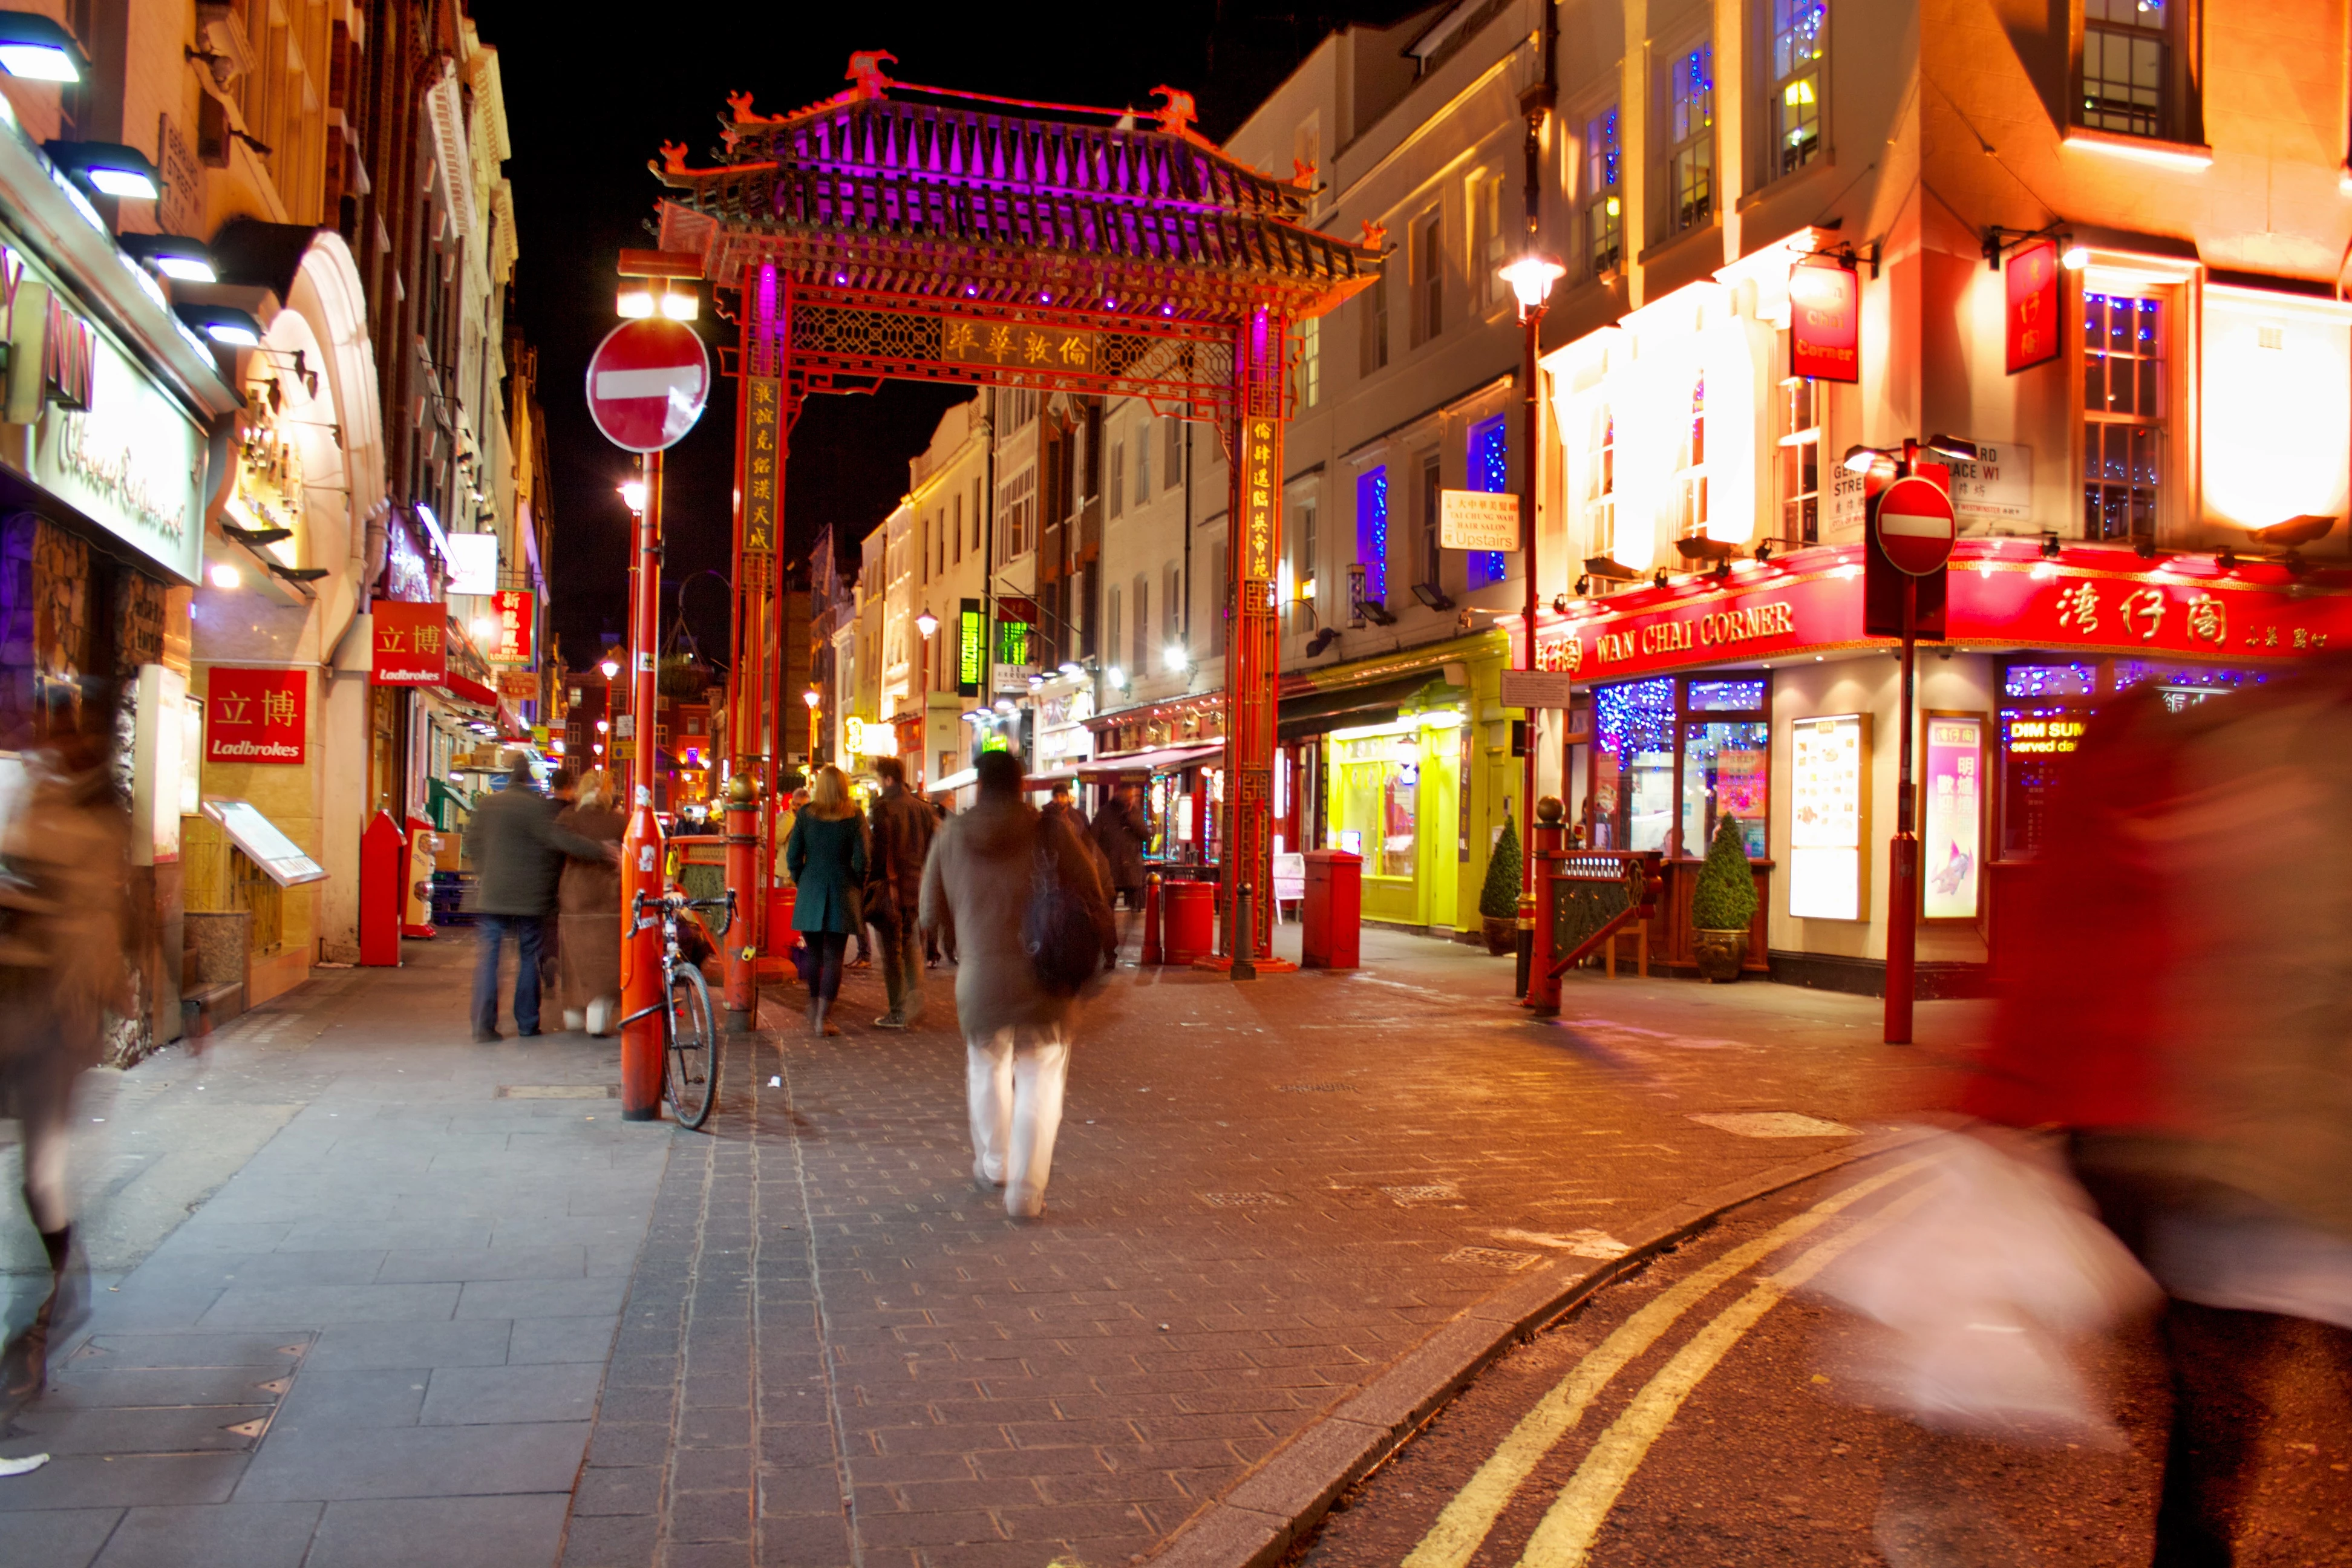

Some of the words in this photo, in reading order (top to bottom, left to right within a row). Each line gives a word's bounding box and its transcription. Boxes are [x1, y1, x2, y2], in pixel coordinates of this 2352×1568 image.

[1806, 309, 1845, 328] Chai
[1796, 339, 1854, 361] Corner
[1982, 466, 1999, 481] W1
[1834, 477, 1866, 497] STRE
[1465, 512, 1494, 520] CHUNG
[1496, 514, 1514, 522] WAH
[1961, 503, 2001, 514] WESTMINSTER
[1457, 532, 1512, 547] Upstairs
[376, 625, 441, 655] 立博
[1596, 630, 1636, 665] WAN
[1642, 619, 1694, 655] CHAI
[1701, 601, 1795, 646] CORNER
[961, 627, 978, 684] HAOZHAN
[379, 668, 440, 681] Ladbrokes
[215, 689, 298, 727] 立博
[2010, 722, 2045, 738] DIM
[2048, 722, 2086, 737] SUM
[212, 739, 299, 757] Ladbrokes
[2011, 739, 2056, 753] served
